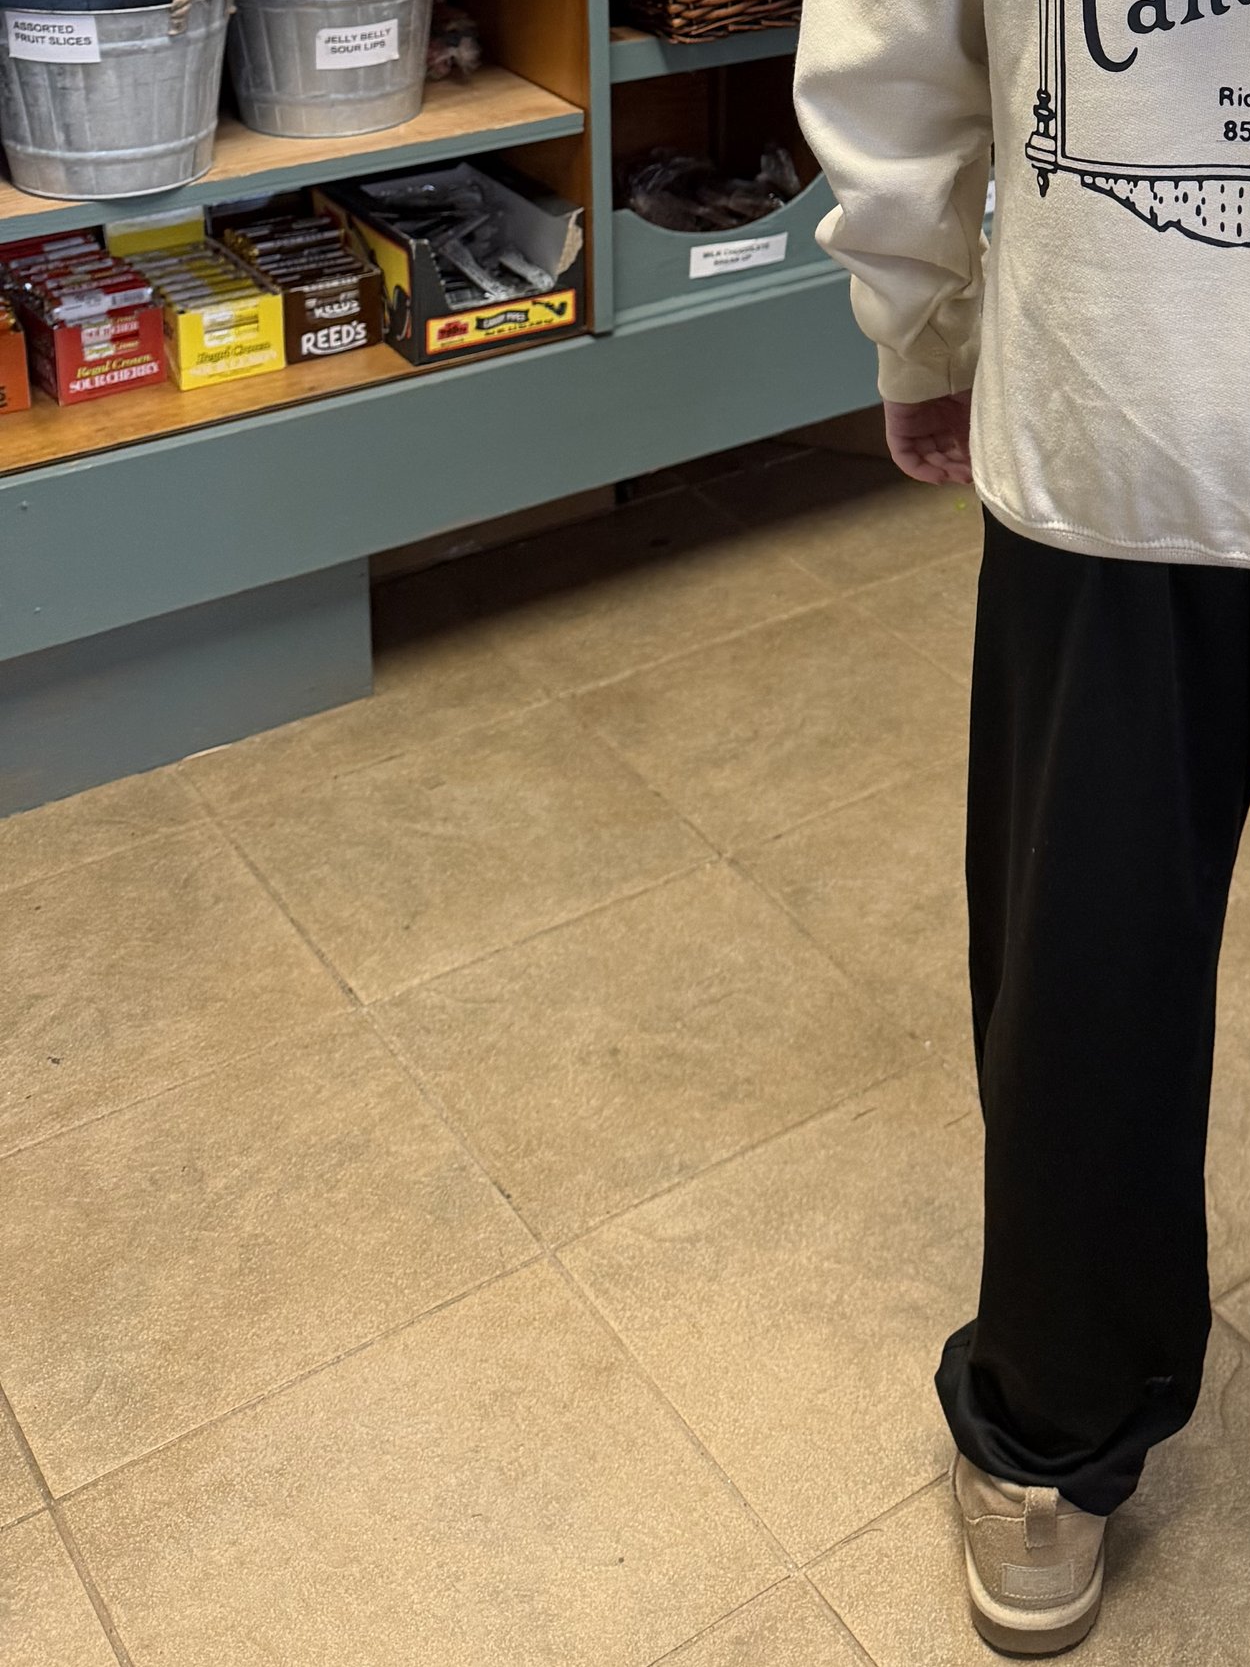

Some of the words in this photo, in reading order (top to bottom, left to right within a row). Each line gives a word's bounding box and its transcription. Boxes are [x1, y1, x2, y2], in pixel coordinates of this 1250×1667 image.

[13, 21, 74, 34] ASSORTED
[14, 32, 46, 45] FRUIT
[48, 36, 92, 46] SLICES
[324, 34, 358, 45] JELLY
[360, 28, 392, 39] BELLY
[330, 44, 361, 54] SOUR
[364, 40, 386, 51] LIPS
[301, 320, 368, 356] REED'S
